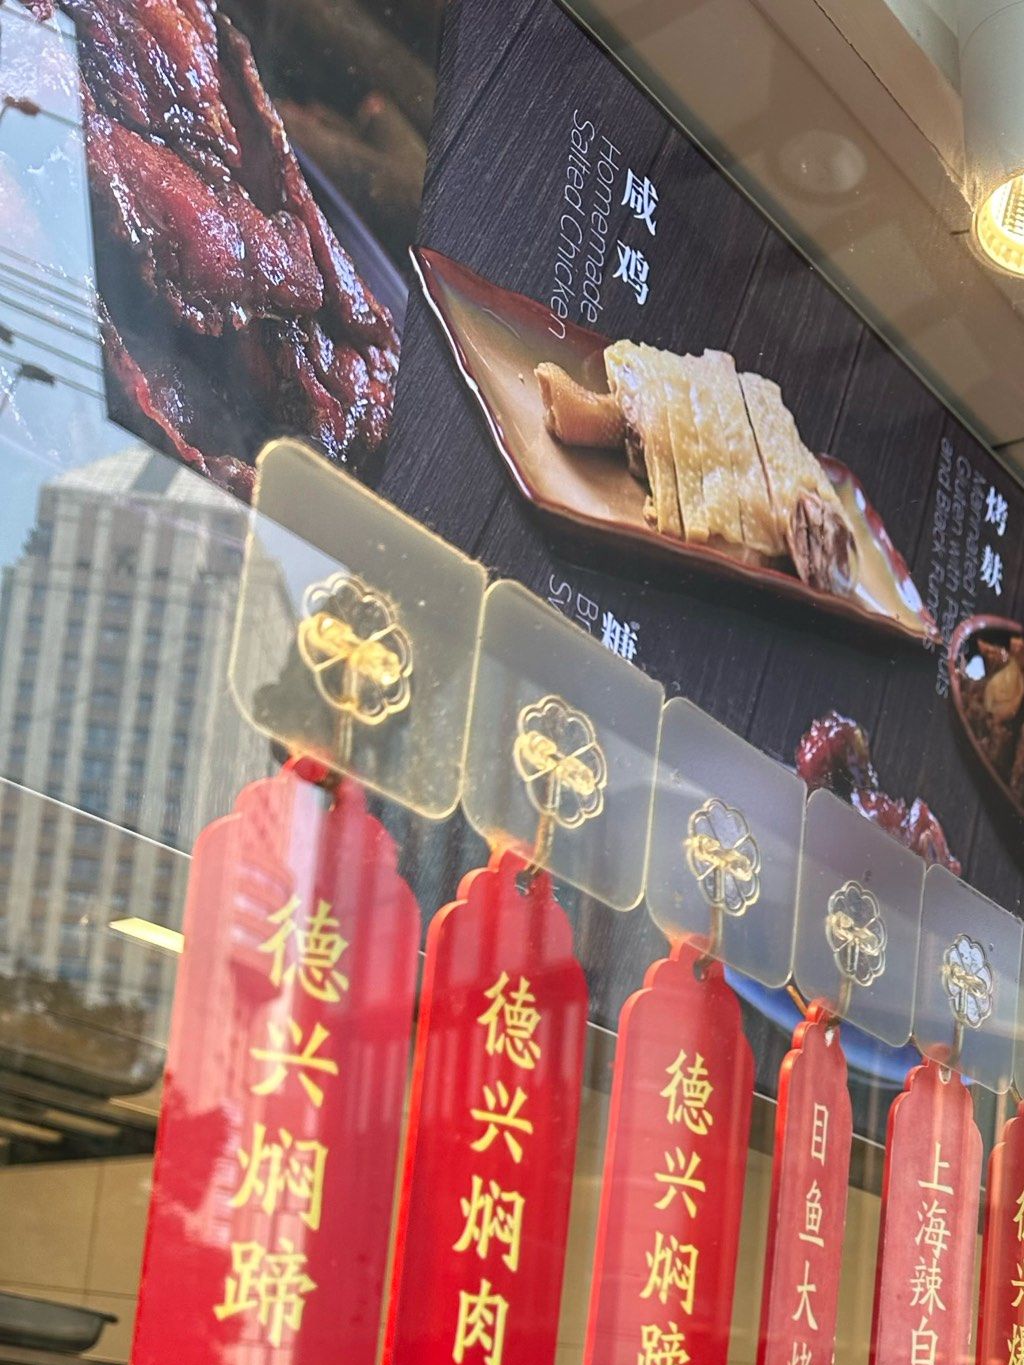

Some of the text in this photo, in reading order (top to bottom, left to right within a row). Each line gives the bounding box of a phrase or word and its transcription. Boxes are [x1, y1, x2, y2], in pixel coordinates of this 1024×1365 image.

[548, 109, 596, 340] Salted Chicken
[580, 135, 622, 323] Homemade
[612, 168, 659, 305] 咸鸡
[937, 437, 953, 488] and
[949, 455, 972, 536] Gluten
[213, 892, 351, 1349] 德兴焖蹄
